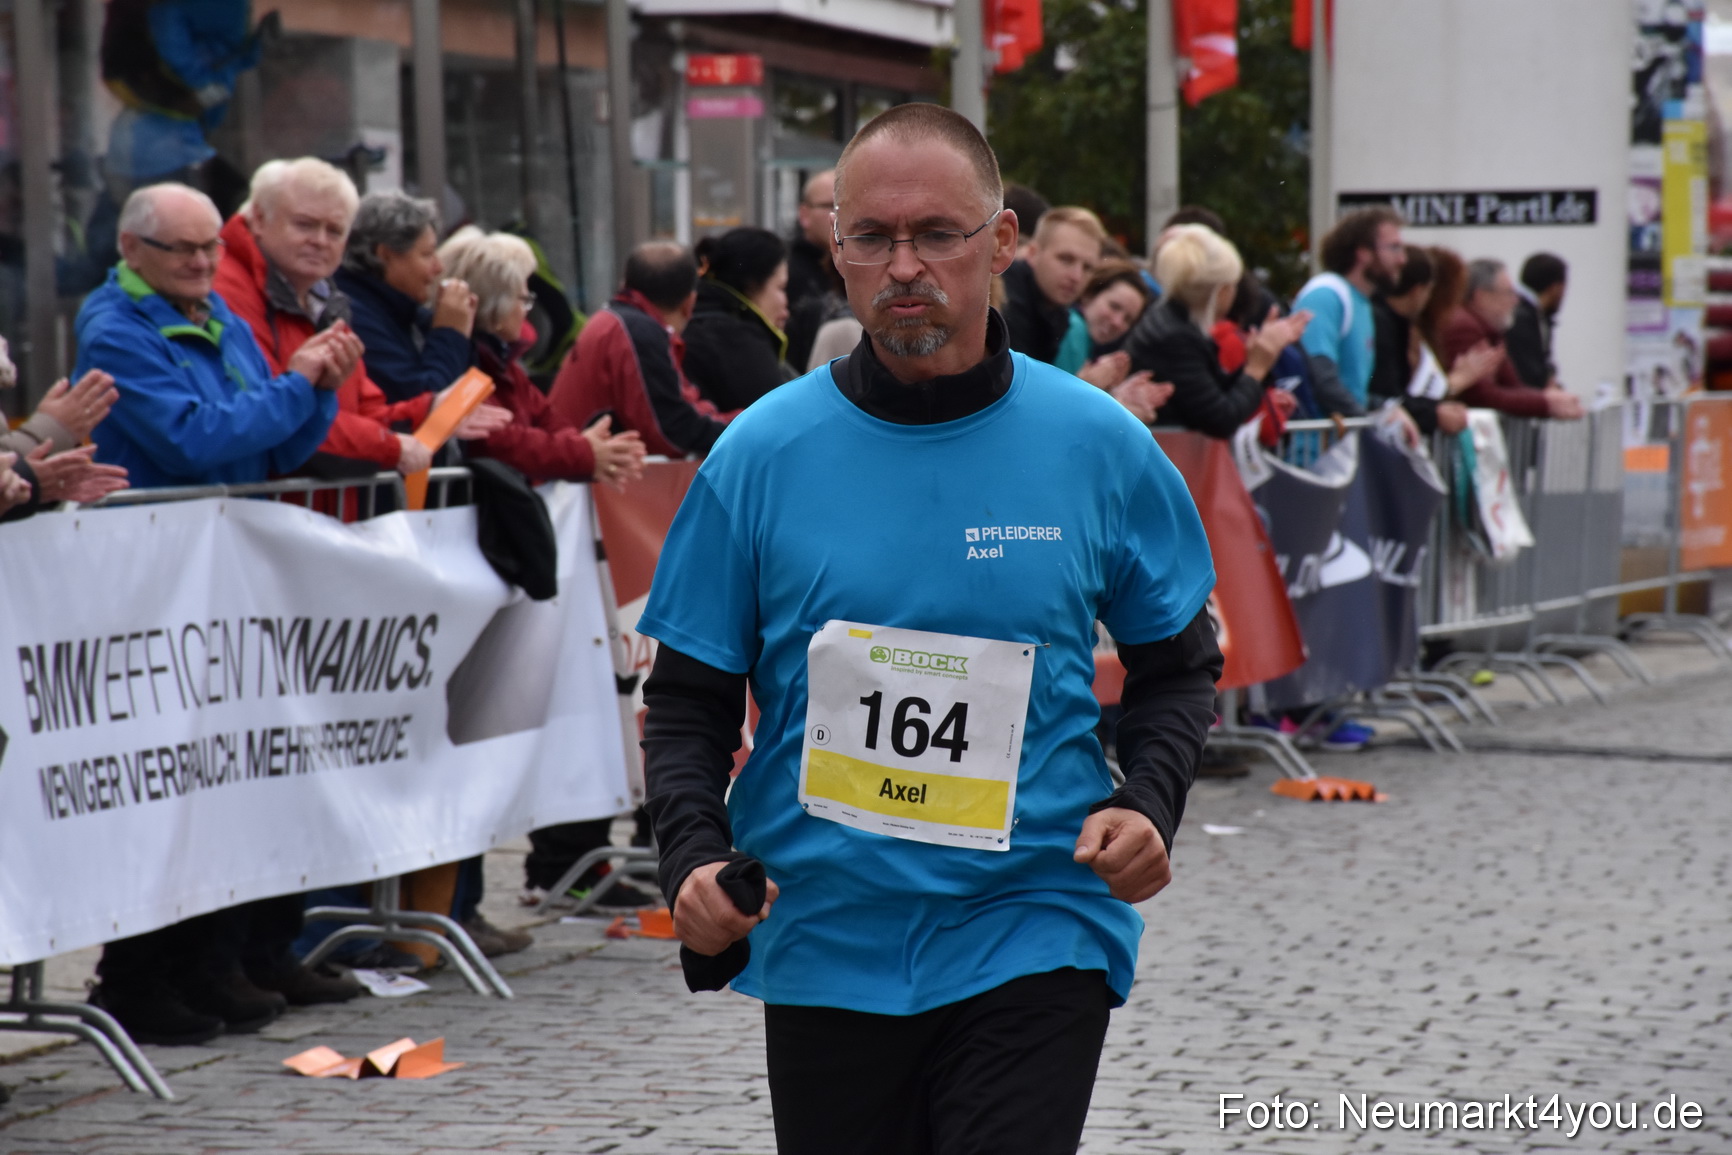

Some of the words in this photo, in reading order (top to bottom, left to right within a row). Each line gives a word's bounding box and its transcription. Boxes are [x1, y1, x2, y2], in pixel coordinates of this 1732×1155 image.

[982, 526, 1063, 541] PFLEIDERER
[966, 544, 1004, 560] Axel
[892, 648, 969, 674] BOCK
[890, 665, 915, 674] inspired
[924, 670, 941, 678] smart
[942, 672, 968, 681] concepts
[18, 636, 101, 734] BMW
[816, 729, 825, 741] D
[859, 690, 969, 763] 164
[879, 778, 927, 804] Axel
